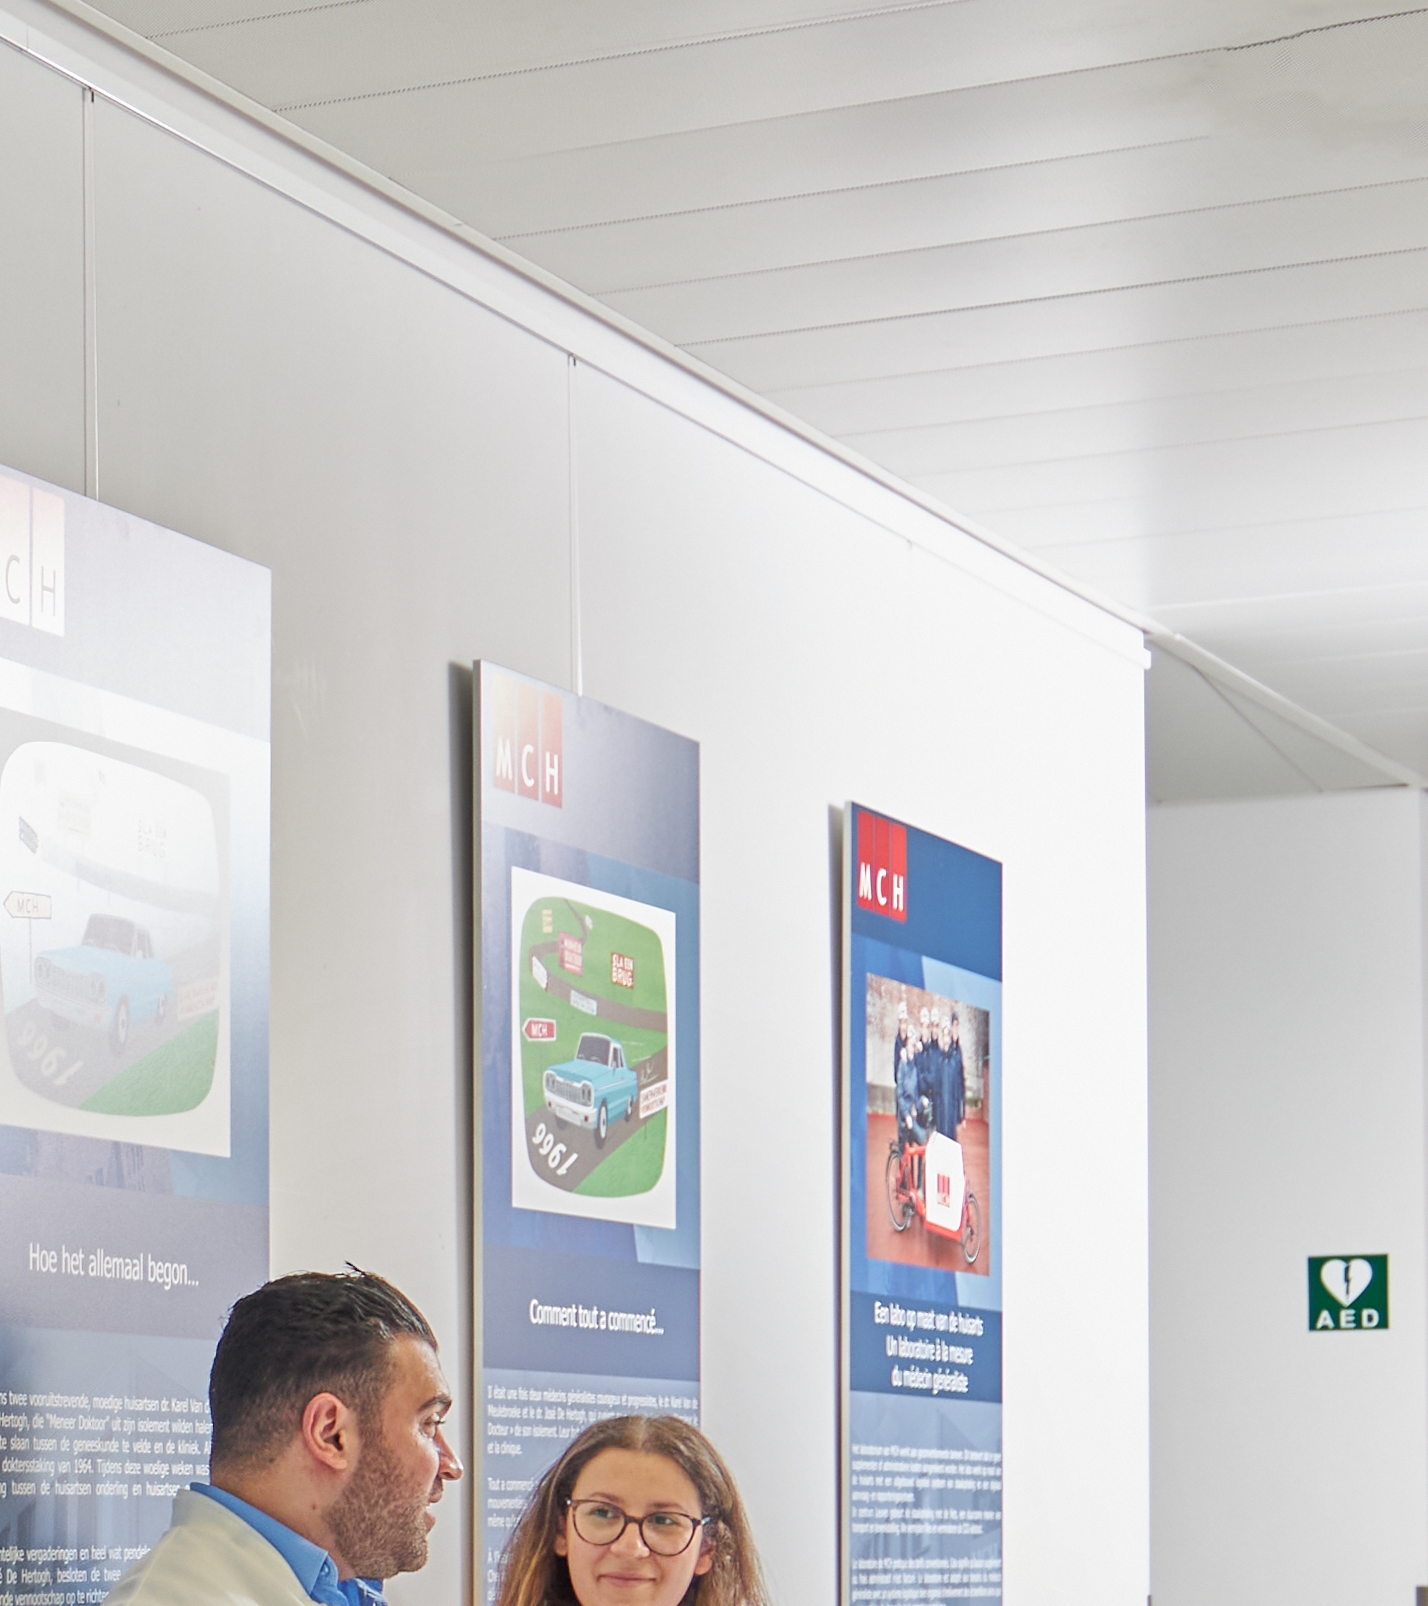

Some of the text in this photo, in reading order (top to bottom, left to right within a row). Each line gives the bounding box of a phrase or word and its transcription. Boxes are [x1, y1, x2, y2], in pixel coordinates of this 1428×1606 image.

[496, 736, 558, 795] MCH
[859, 862, 903, 911] MCH
[17, 898, 39, 914] MCH
[612, 967, 633, 987] BRUG
[531, 1023, 548, 1038] MCH
[532, 1123, 578, 1176] 1966
[29, 1241, 198, 1291] Hoe het allemaal begon...
[530, 1298, 577, 1327] Comment
[578, 1304, 598, 1329] tout
[598, 1310, 606, 1330] a
[874, 1301, 889, 1324] Een
[1315, 1308, 1380, 1330] AED
